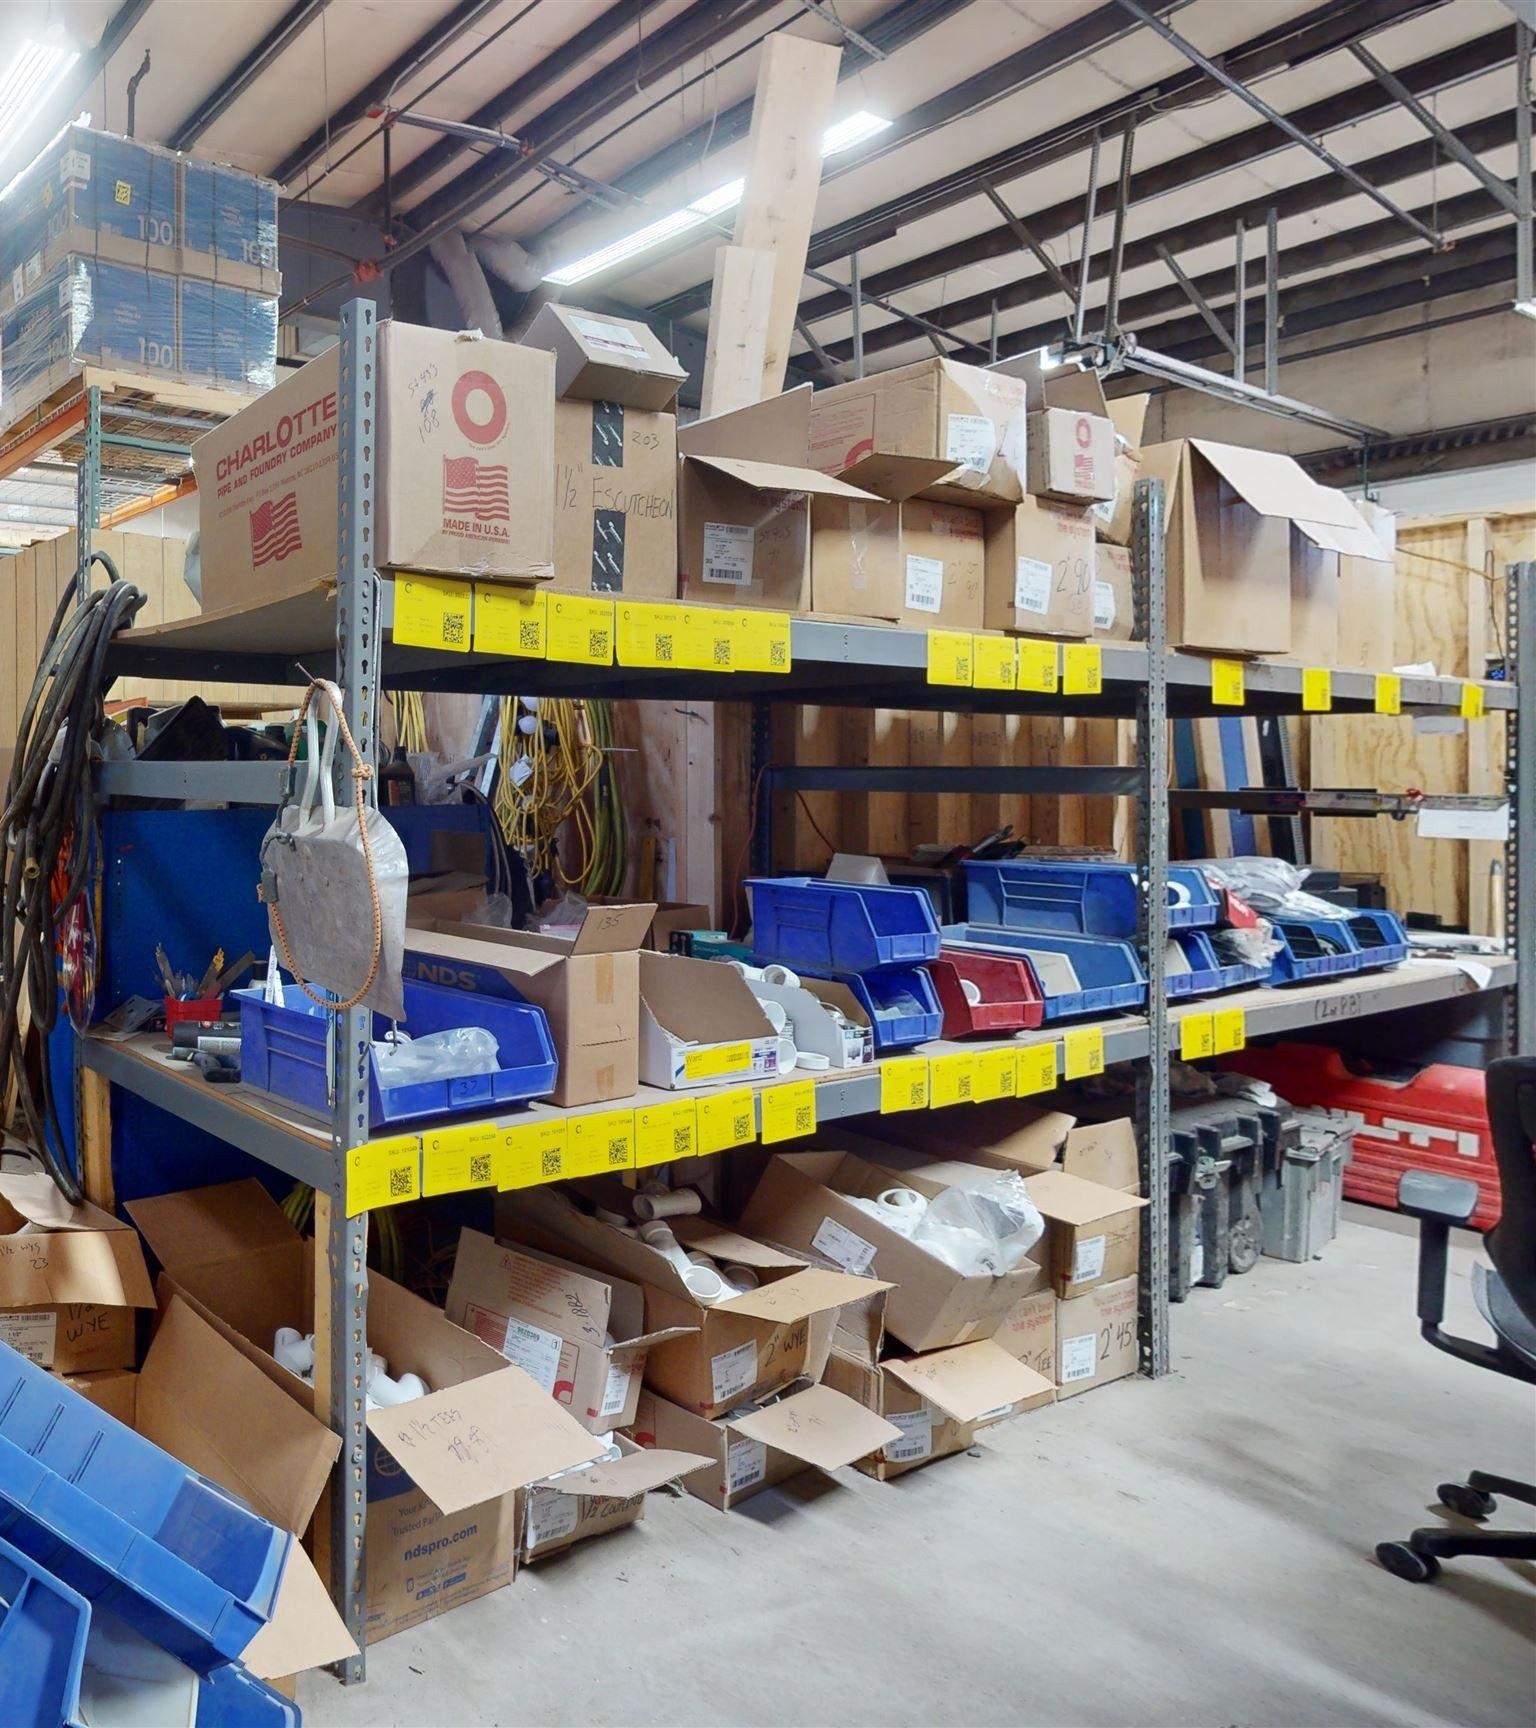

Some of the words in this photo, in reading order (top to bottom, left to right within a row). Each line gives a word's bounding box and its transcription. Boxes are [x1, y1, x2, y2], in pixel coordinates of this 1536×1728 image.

[137, 214, 174, 245] 100
[138, 338, 174, 367] 100
[216, 392, 337, 481] CHARLOTTE
[632, 431, 660, 450] 203
[217, 482, 232, 499] PIPE
[233, 475, 247, 490] AND
[250, 452, 287, 480] FOUNDRY
[290, 424, 337, 458] COMPANY
[592, 477, 674, 520] ESCUTCHEON
[443, 518, 470, 532] MADE
[473, 523, 482, 533] IN
[485, 525, 510, 538] U.S.A.
[417, 962, 478, 990] NDS
[1330, 1107, 1480, 1158] LTI
[30, 1257, 49, 1270] 23
[67, 1312, 111, 1342] WYE
[765, 1335, 780, 1368] 2"
[783, 1328, 808, 1353] WYE
[1035, 1348, 1052, 1372] TEE
[399, 1504, 416, 1517] Your
[391, 1519, 423, 1537] Trusted
[404, 1523, 478, 1561] ndspro.com
